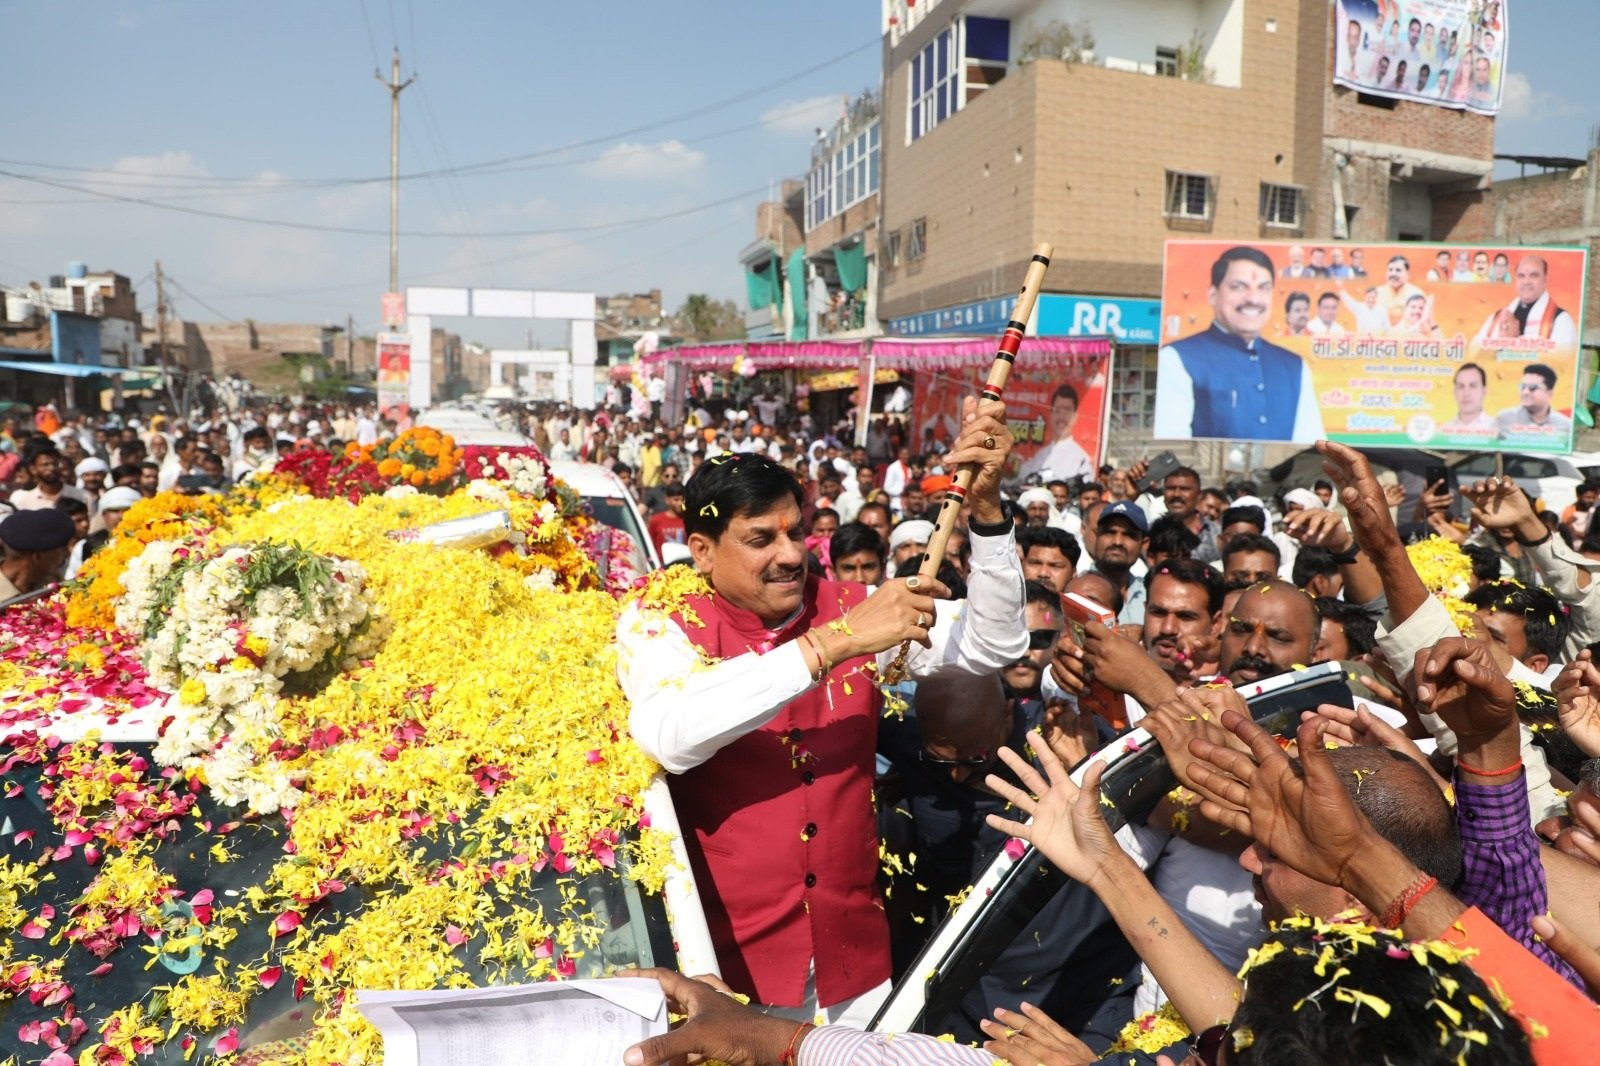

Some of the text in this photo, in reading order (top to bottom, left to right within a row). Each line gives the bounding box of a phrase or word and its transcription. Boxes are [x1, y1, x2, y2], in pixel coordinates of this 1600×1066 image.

[1068, 302, 1127, 338] RR
[1403, 338, 1440, 358] यादव
[1445, 335, 1464, 359] जी
